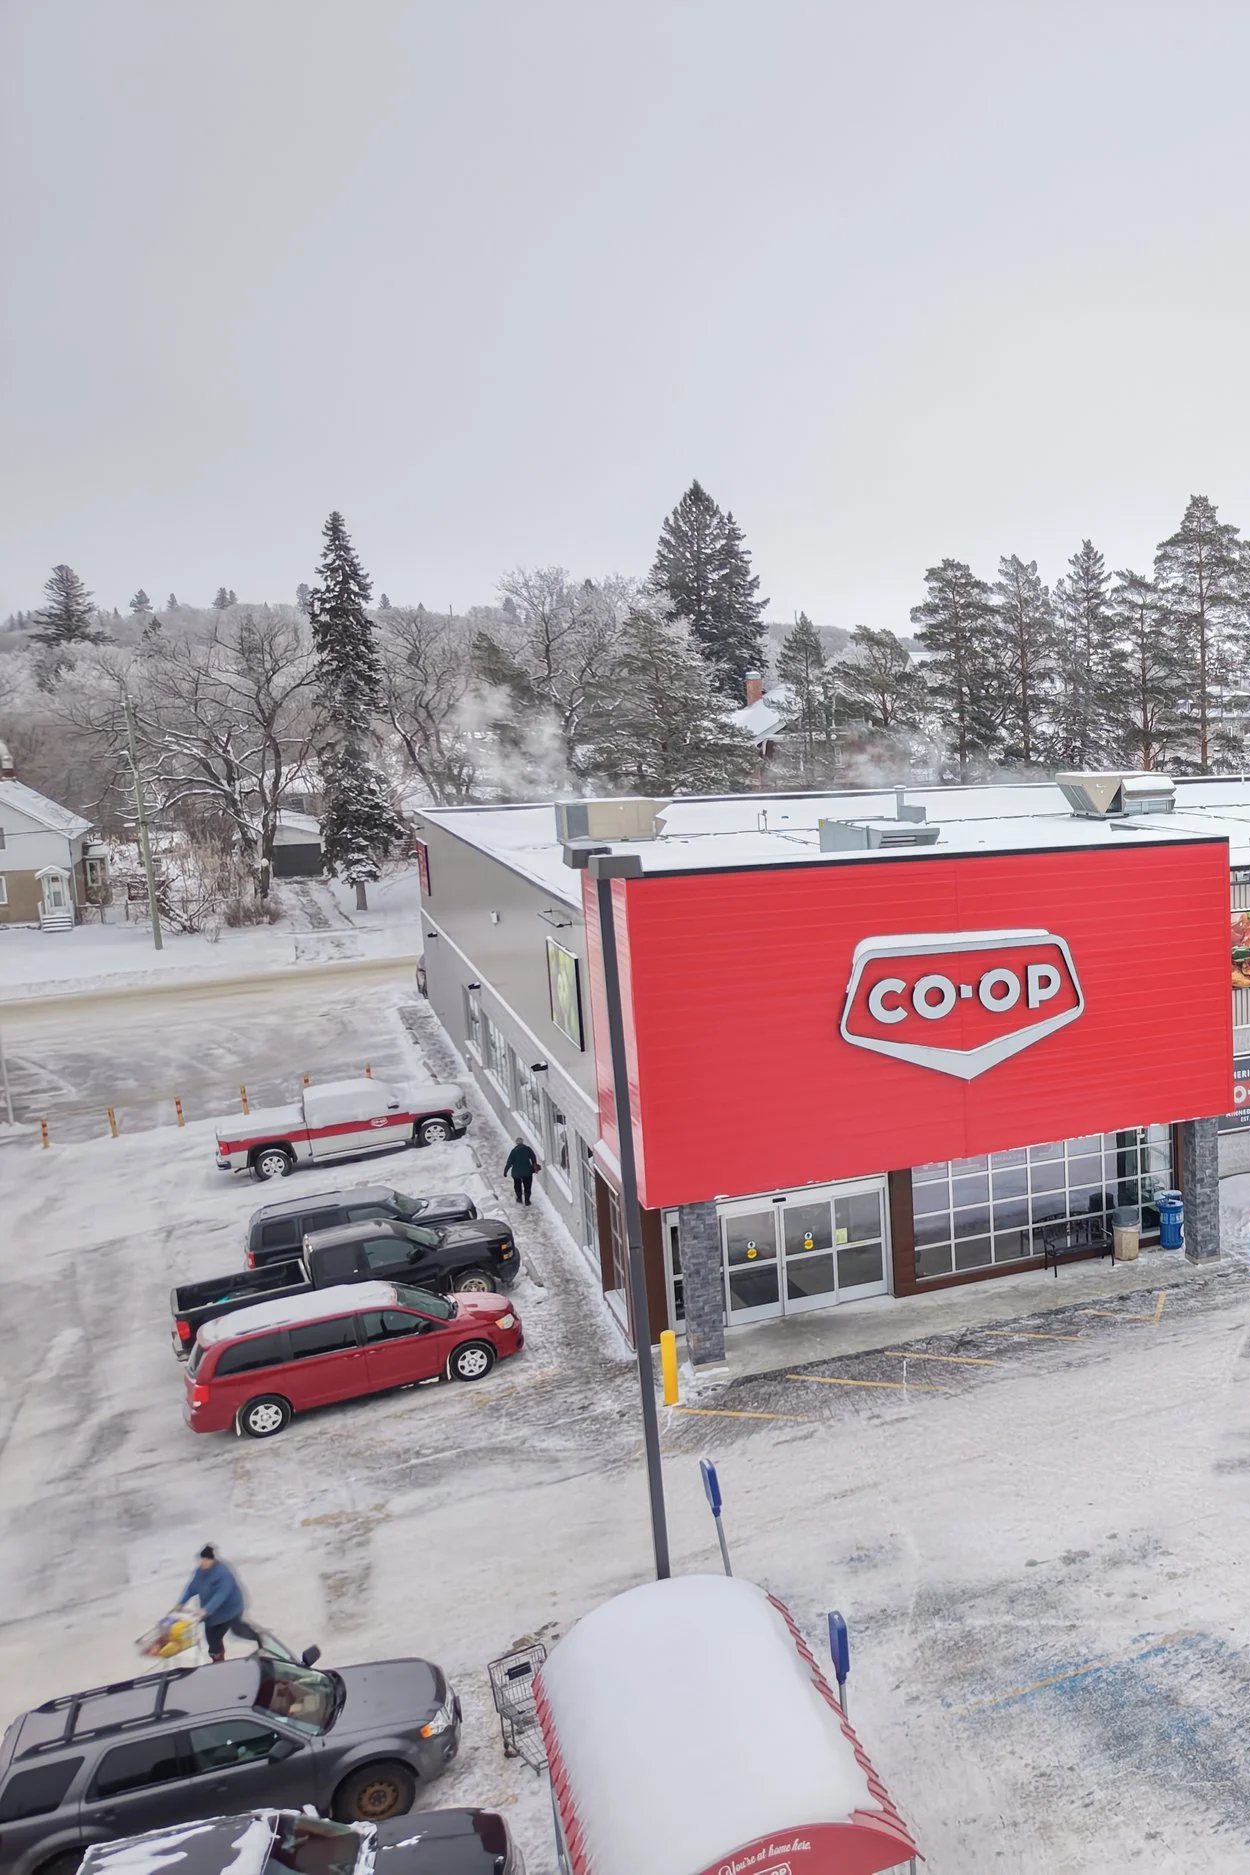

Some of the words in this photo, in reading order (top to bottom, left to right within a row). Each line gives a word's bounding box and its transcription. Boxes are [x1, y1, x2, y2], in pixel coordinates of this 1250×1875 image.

[868, 963, 1061, 1024] CO-OP
[756, 1848, 767, 1861] at
[768, 1844, 791, 1857] home
